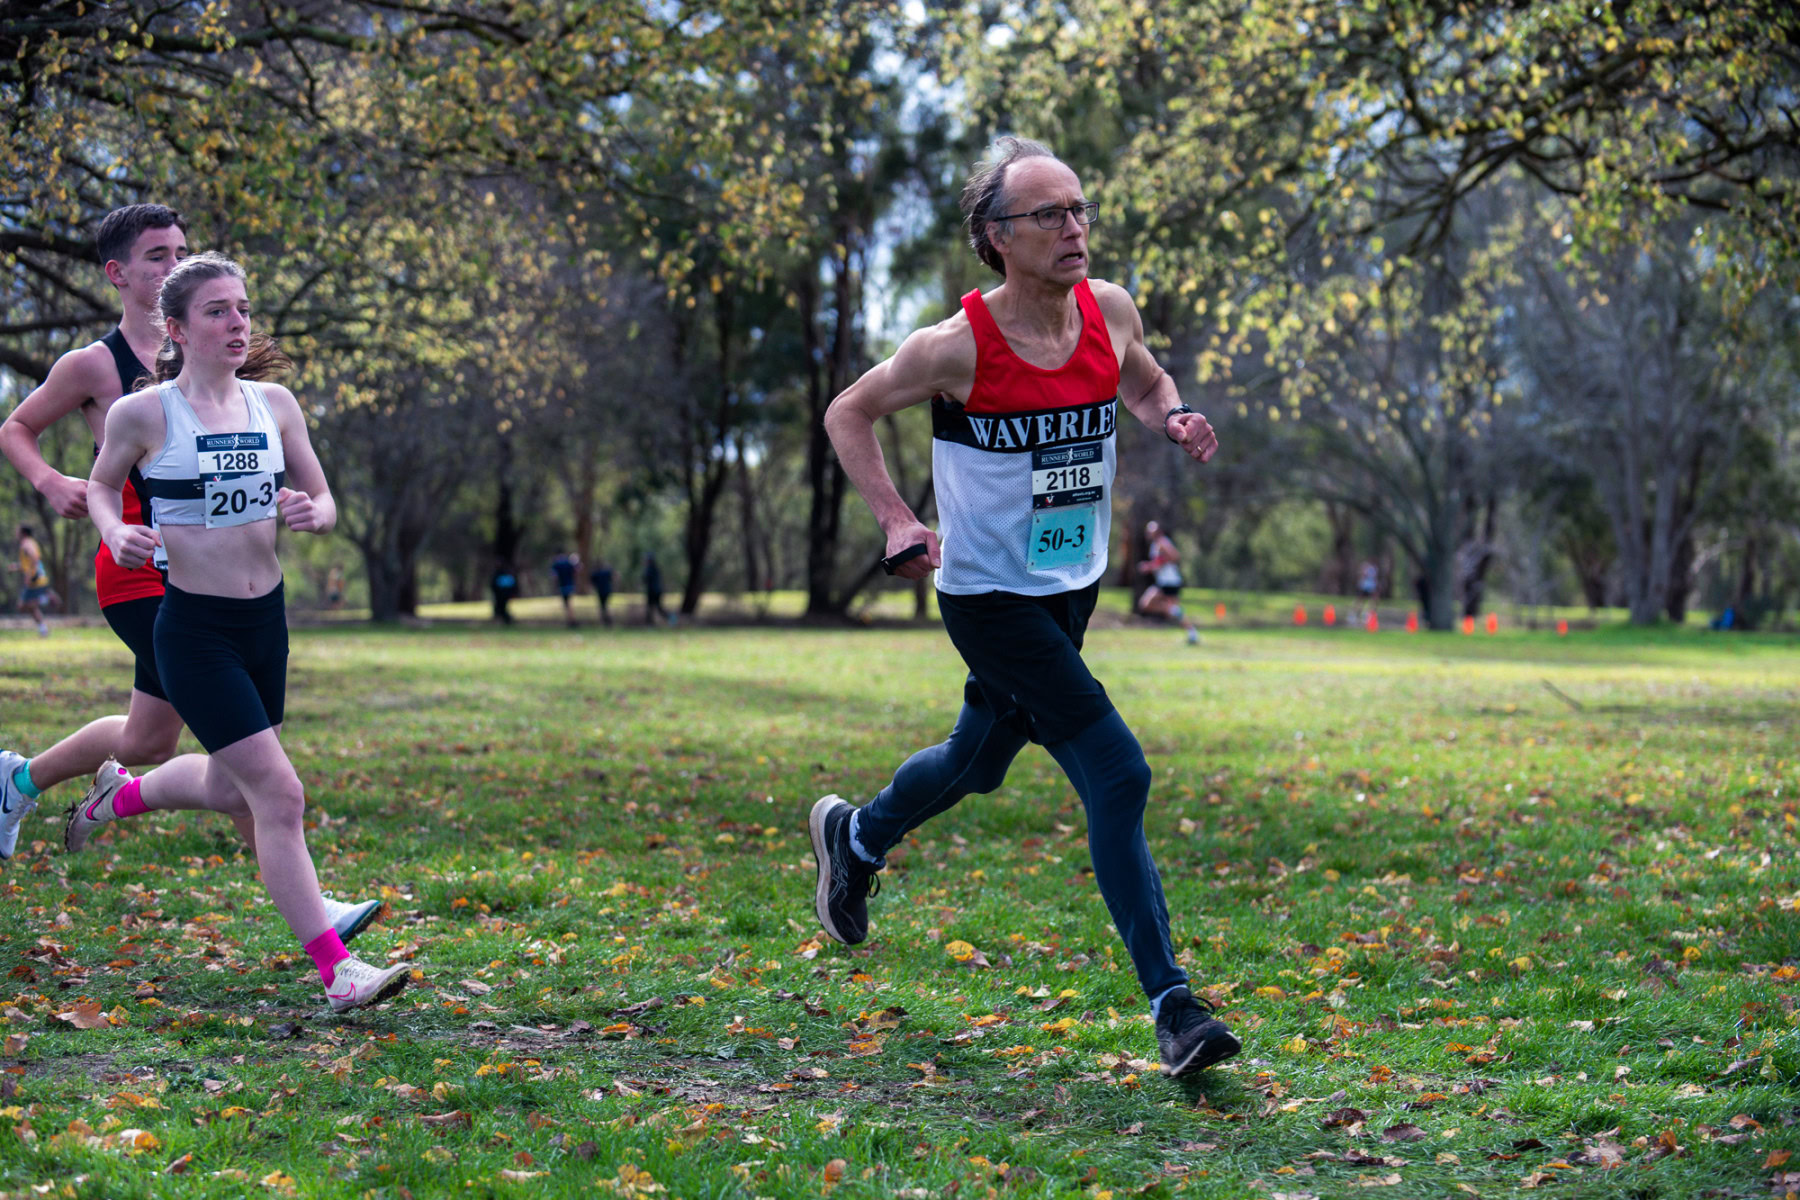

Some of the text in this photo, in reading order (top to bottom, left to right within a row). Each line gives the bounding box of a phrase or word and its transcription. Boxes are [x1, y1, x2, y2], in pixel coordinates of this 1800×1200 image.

[206, 438, 235, 446] RUNNERS
[212, 452, 259, 471] 1288
[1041, 450, 1095, 463] RUNNERS WORLD
[1046, 466, 1091, 491] 2118
[210, 481, 273, 516] 20-3
[1038, 524, 1085, 553] 50-3
